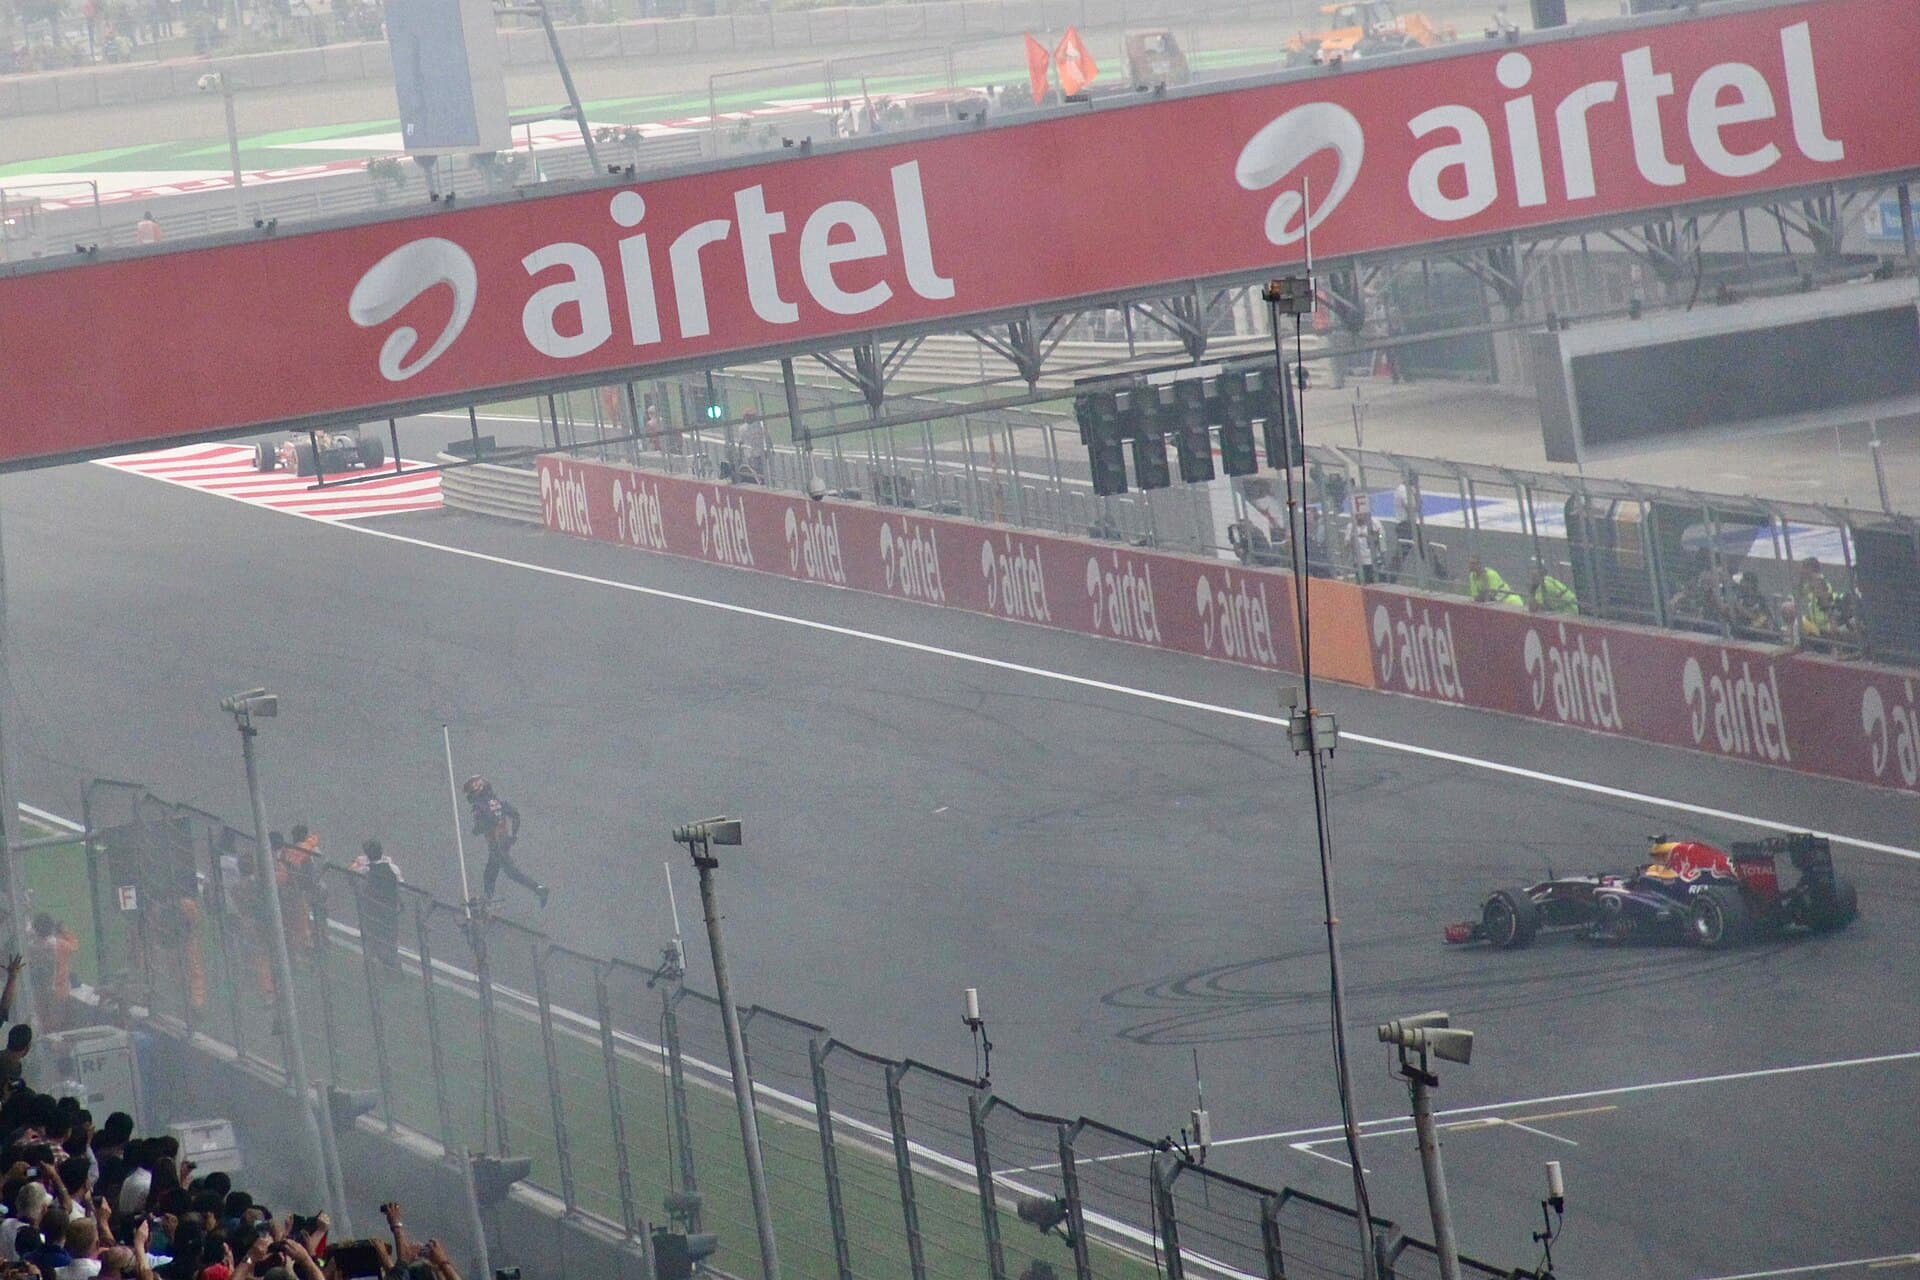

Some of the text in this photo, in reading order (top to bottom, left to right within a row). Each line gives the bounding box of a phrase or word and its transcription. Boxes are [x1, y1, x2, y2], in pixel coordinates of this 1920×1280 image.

[1407, 20, 1846, 222] airtel
[521, 158, 957, 360] airtel
[555, 462, 593, 536] airtel
[627, 472, 668, 549] airtel
[709, 488, 755, 566] airtel
[801, 501, 846, 583] airtel
[897, 517, 945, 601] airtel
[999, 534, 1052, 622] airtel
[1104, 551, 1161, 642] airtel
[1217, 569, 1277, 665] airtel
[1397, 599, 1464, 699] airtel
[1548, 623, 1623, 731] airtel
[1710, 650, 1792, 762] airtel
